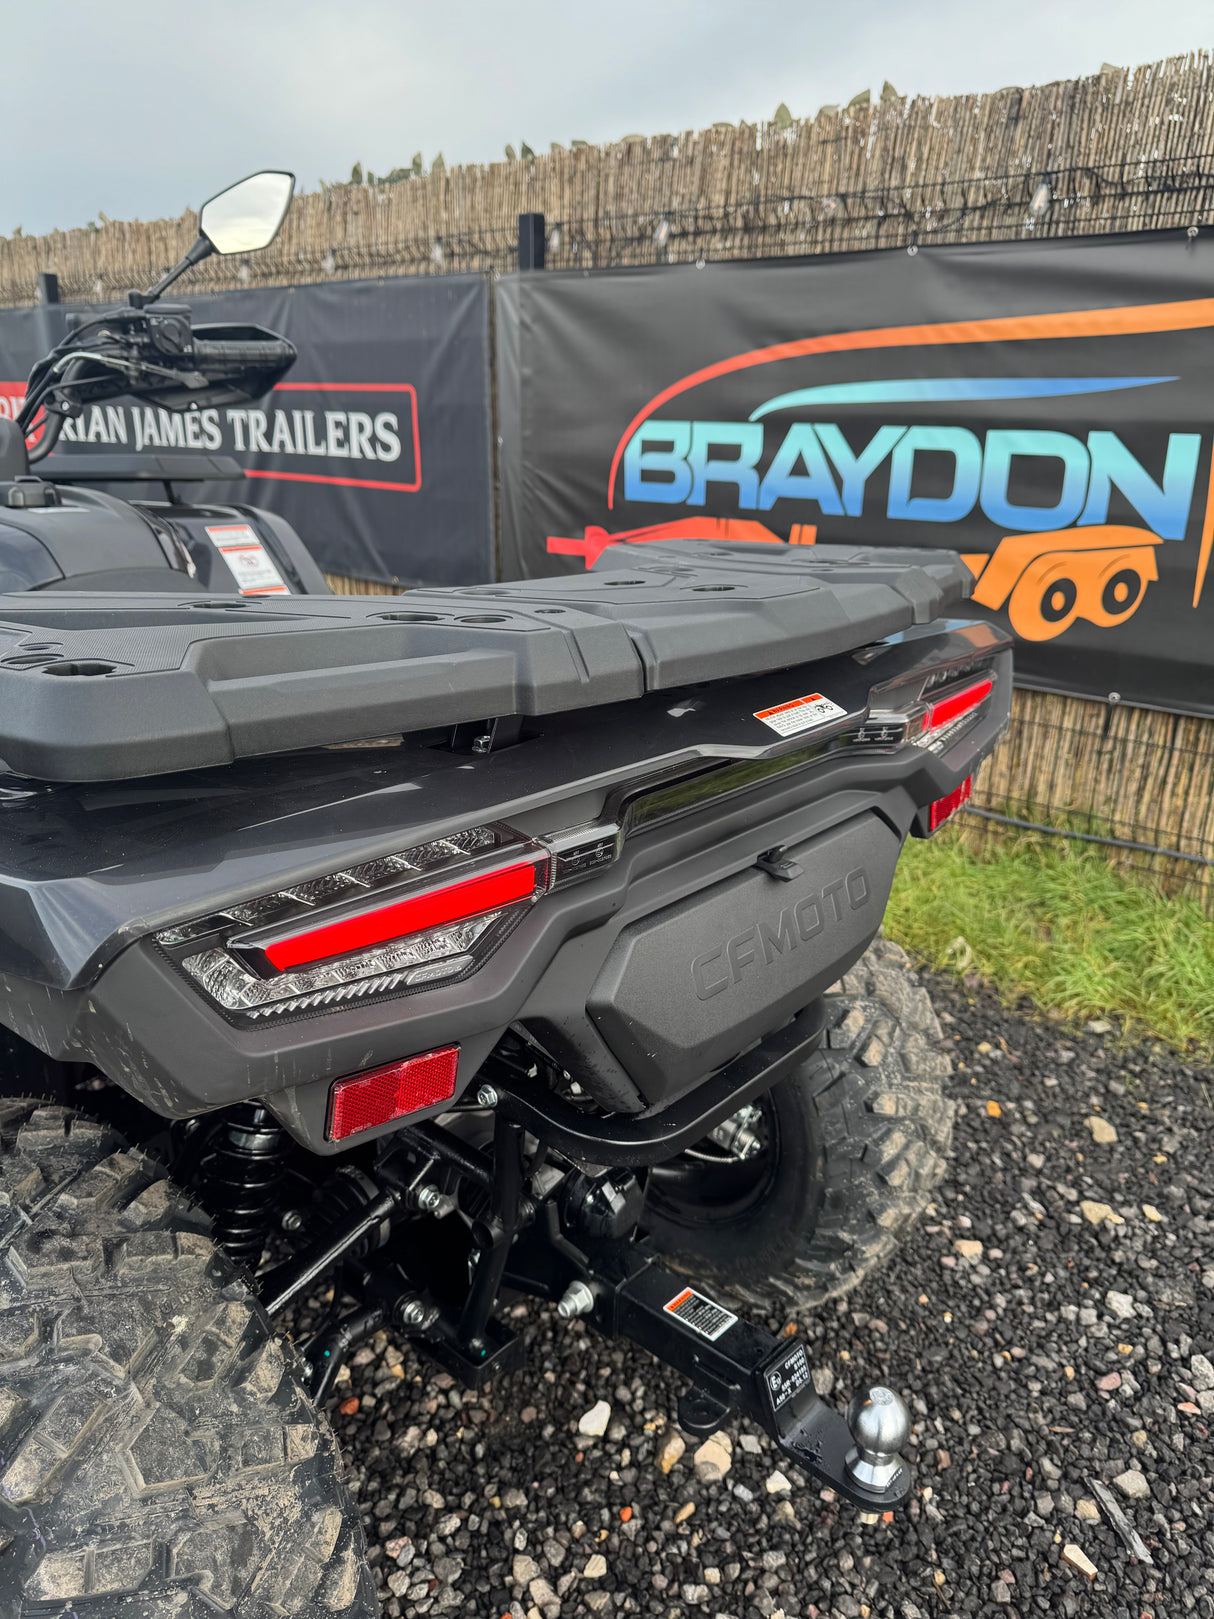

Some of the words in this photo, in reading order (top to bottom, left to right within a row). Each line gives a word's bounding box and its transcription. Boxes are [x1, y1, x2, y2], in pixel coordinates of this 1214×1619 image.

[58, 405, 128, 444] RIAN
[131, 405, 223, 451] JAMES
[226, 409, 402, 462] TRAILERS
[624, 420, 1202, 540] BRAYDON
[690, 866, 871, 1001] CFMOTO
[784, 1349, 803, 1370] CFMOTO
